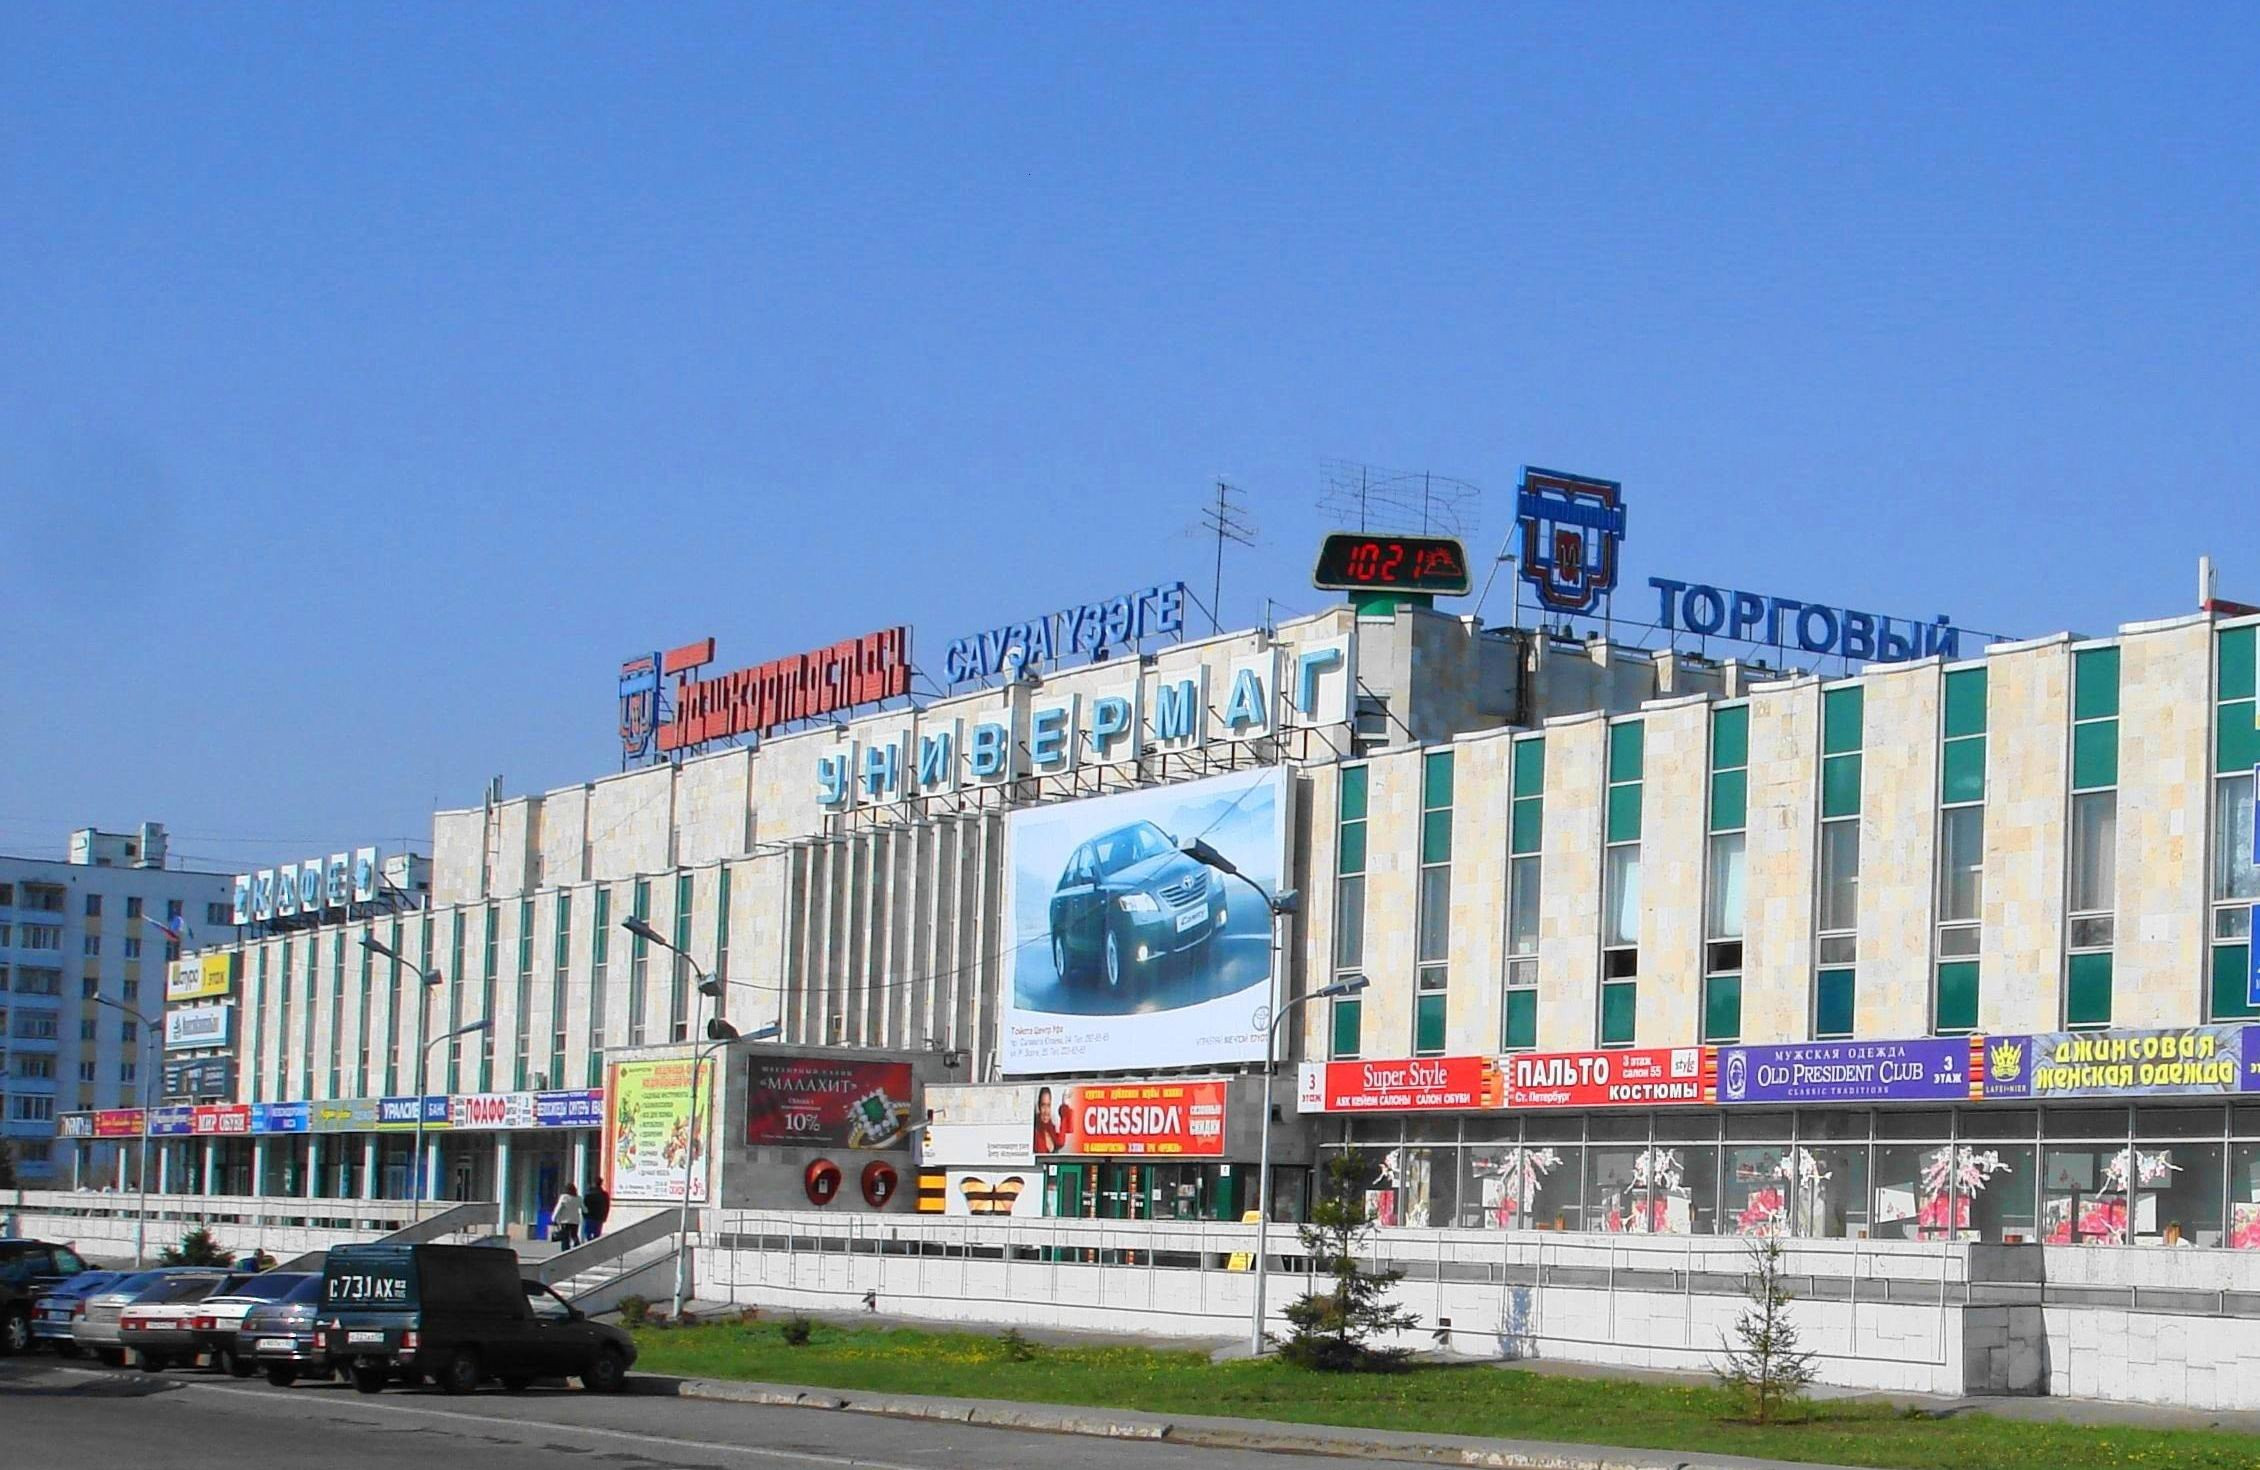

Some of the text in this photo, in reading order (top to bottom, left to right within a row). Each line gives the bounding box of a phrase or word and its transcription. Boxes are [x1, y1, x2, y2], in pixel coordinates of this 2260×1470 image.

[1648, 577, 1960, 663] ТОРГОВЫЙ
[816, 647, 1342, 805] УНИВЕРМАГ
[1775, 1046, 1906, 1061] МУЖСКАЯ ОДЕЖДА
[1516, 1056, 1610, 1088] ПАЛЬТО
[1943, 1055, 1953, 1072] 3
[1309, 1073, 1316, 1090] 3
[1363, 1061, 1448, 1094] Super Style
[1933, 1072, 1962, 1084] ЭТАЖ
[1379, 1094, 1412, 1105] САЛОНЫ
[1416, 1093, 1442, 1105] САЛОН
[1609, 1083, 1698, 1101] КОСТЮМЫ
[785, 1112, 821, 1132] 10%
[1084, 1105, 1182, 1136] CRESSIDA
